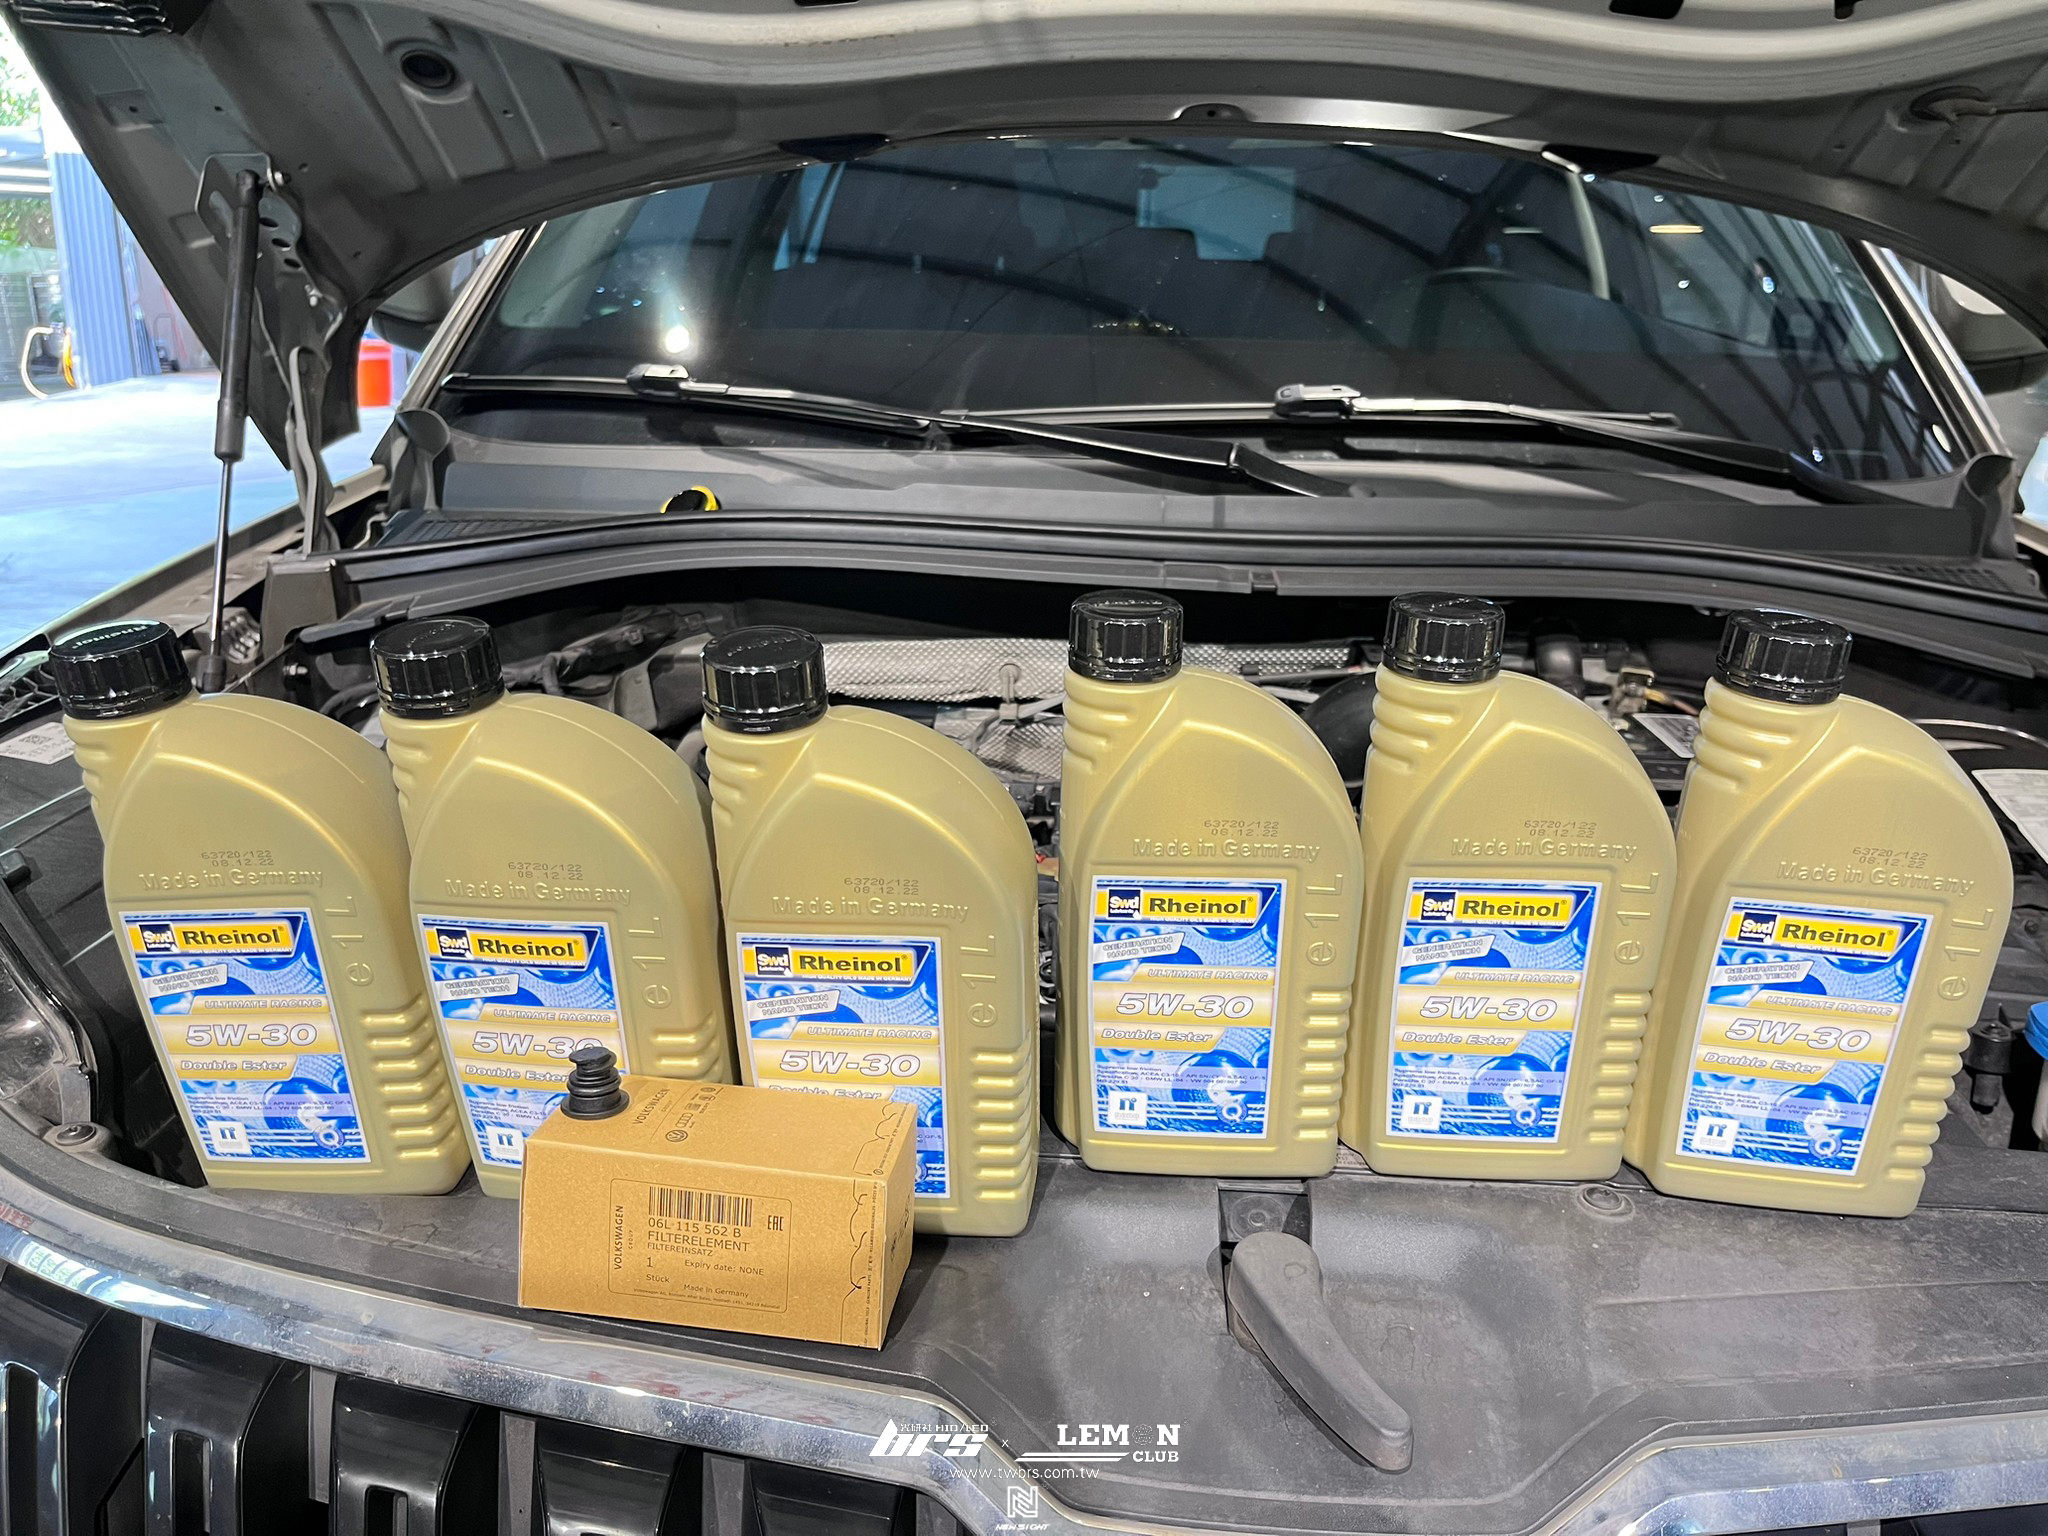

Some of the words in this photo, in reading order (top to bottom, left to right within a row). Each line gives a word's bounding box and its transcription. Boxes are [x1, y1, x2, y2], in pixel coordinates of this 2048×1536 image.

[1204, 820, 1279, 828] 63720/122
[1524, 820, 1597, 829] 63720/122
[1211, 829, 1278, 837] 08.12.22
[1530, 829, 1595, 838] 08.12.22
[201, 851, 272, 860] 63720/122
[1133, 839, 1192, 857] Made
[1198, 838, 1215, 857] in
[1222, 839, 1320, 862] Germany
[1451, 838, 1507, 856] Made
[1516, 838, 1534, 856] in
[1539, 839, 1637, 861] Germany
[1852, 847, 1928, 860] 63720/122
[211, 858, 274, 867] 08.12.22
[508, 862, 582, 872] 63720/122
[139, 872, 199, 890] Made
[203, 870, 224, 886] in
[228, 869, 323, 887] Germany
[518, 871, 583, 880] 08.12.22
[844, 878, 919, 887] 63720/122
[1776, 861, 1836, 883] Made
[1844, 865, 1862, 883] in
[1870, 868, 1974, 896] Germany
[445, 879, 503, 899] Made
[509, 882, 529, 899] in
[534, 882, 631, 905] Germany
[854, 886, 919, 895] 08.12.22
[773, 896, 834, 914] Made
[842, 897, 861, 914] in
[868, 897, 968, 921] Germany
[1150, 898, 1246, 914] Rheinol
[1463, 900, 1559, 917] Rheinol
[182, 929, 280, 945] Rheinol
[1782, 923, 1885, 947] Rheinol
[478, 939, 575, 956] Rheinol
[1103, 936, 1173, 951] GENERATION
[1412, 939, 1483, 954] GENERATION
[1107, 947, 1140, 958] NANO
[1142, 944, 1171, 954] TECH
[1416, 950, 1448, 961] NANO
[1450, 947, 1481, 957] TECH
[800, 955, 900, 971] Rheinol
[1724, 964, 1800, 974] GENERATION
[153, 968, 218, 985] GENERATION
[1148, 970, 1213, 979] ULTIMATE
[1216, 970, 1268, 980] RACING
[1455, 972, 1518, 982] ULTIMATE
[1522, 974, 1574, 984] RACING
[1728, 972, 1762, 982] NANO
[1764, 971, 1797, 980] TECH
[159, 979, 190, 992] NANO
[191, 976, 219, 989] TECH
[445, 977, 509, 990] GENERATION
[450, 986, 484, 997] NANO
[484, 985, 510, 994] TECH
[205, 1000, 266, 1009] ULTIMATE
[271, 999, 322, 1008] RACING
[757, 994, 829, 1008] GENERATION
[1116, 993, 1254, 1018] 5W-30
[1766, 996, 1834, 1010] ULTIMATE
[1836, 1002, 1892, 1016] RACING
[762, 1004, 793, 1015] NANO
[796, 1002, 827, 1011] TECH
[1420, 996, 1557, 1022] 5W-30
[494, 1009, 555, 1020] ULTIMATE
[559, 1013, 610, 1023] RACING
[186, 1024, 317, 1046] 5W-30
[808, 1027, 873, 1037] ULTIMATE
[877, 1029, 932, 1039] RACING
[1102, 1029, 1160, 1040] Double
[1165, 1032, 1213, 1042] Ester
[1402, 1032, 1461, 1044] Double
[1466, 1035, 1513, 1046] Ester
[1726, 1017, 1871, 1052] 5W-30
[181, 1061, 237, 1070] Double
[242, 1061, 286, 1070] Ester
[780, 1050, 920, 1077] 5W-30
[1704, 1052, 1766, 1069] Double
[1771, 1060, 1821, 1074] Ester
[466, 1065, 520, 1079] Double
[525, 1070, 568, 1082] Ester
[632, 1088, 670, 1124] VOLKSWAGEN
[648, 1218, 671, 1229] 06L
[678, 1222, 699, 1232] 115
[705, 1224, 727, 1236] 562
[733, 1227, 741, 1237] B
[614, 1206, 623, 1270] VOLKSWAGEN
[648, 1231, 750, 1252] FILTERELEMENT
[647, 1243, 713, 1257] FILTEREINSATZ
[647, 1257, 653, 1268] 1
[685, 1260, 710, 1271] Expiry
[714, 1263, 736, 1272] date:
[739, 1267, 764, 1276] NONE
[646, 1274, 670, 1283] Stück
[684, 1284, 704, 1292] Made
[715, 1288, 749, 1298] Germany
